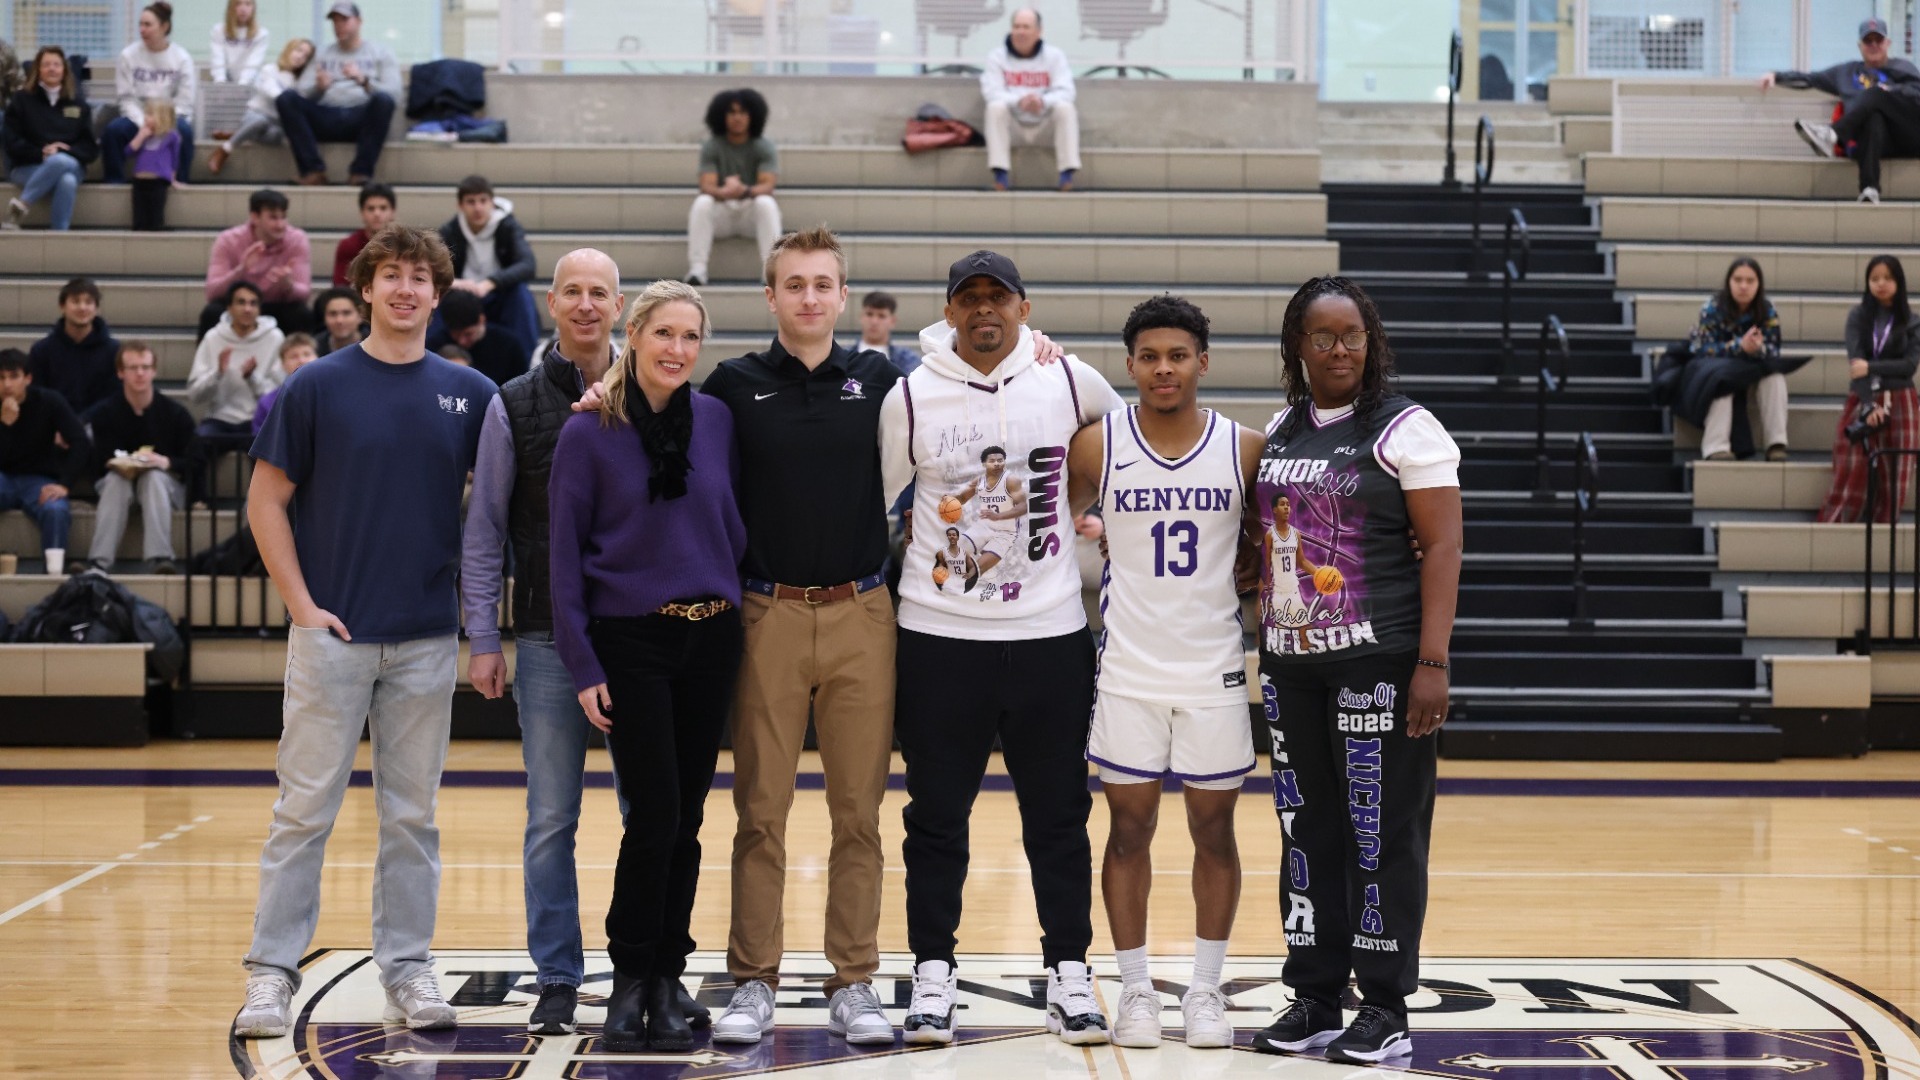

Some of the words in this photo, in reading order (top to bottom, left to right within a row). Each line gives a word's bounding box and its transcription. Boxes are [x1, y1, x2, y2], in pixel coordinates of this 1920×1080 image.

[1334, 446, 1357, 456] OWLS
[1257, 459, 1329, 486] ENIOR
[1305, 472, 1360, 497] 2026
[1028, 446, 1066, 562] OWLS
[1114, 487, 1232, 512] KENYON
[1151, 520, 1199, 577] 13
[1282, 556, 1291, 573] 13
[1266, 620, 1379, 657] NELSON
[1337, 686, 1373, 709] Class
[1374, 682, 1397, 711] Of
[1337, 711, 1394, 732] 2026
[1284, 932, 1316, 946] MOM
[1352, 934, 1399, 952] KENYON
